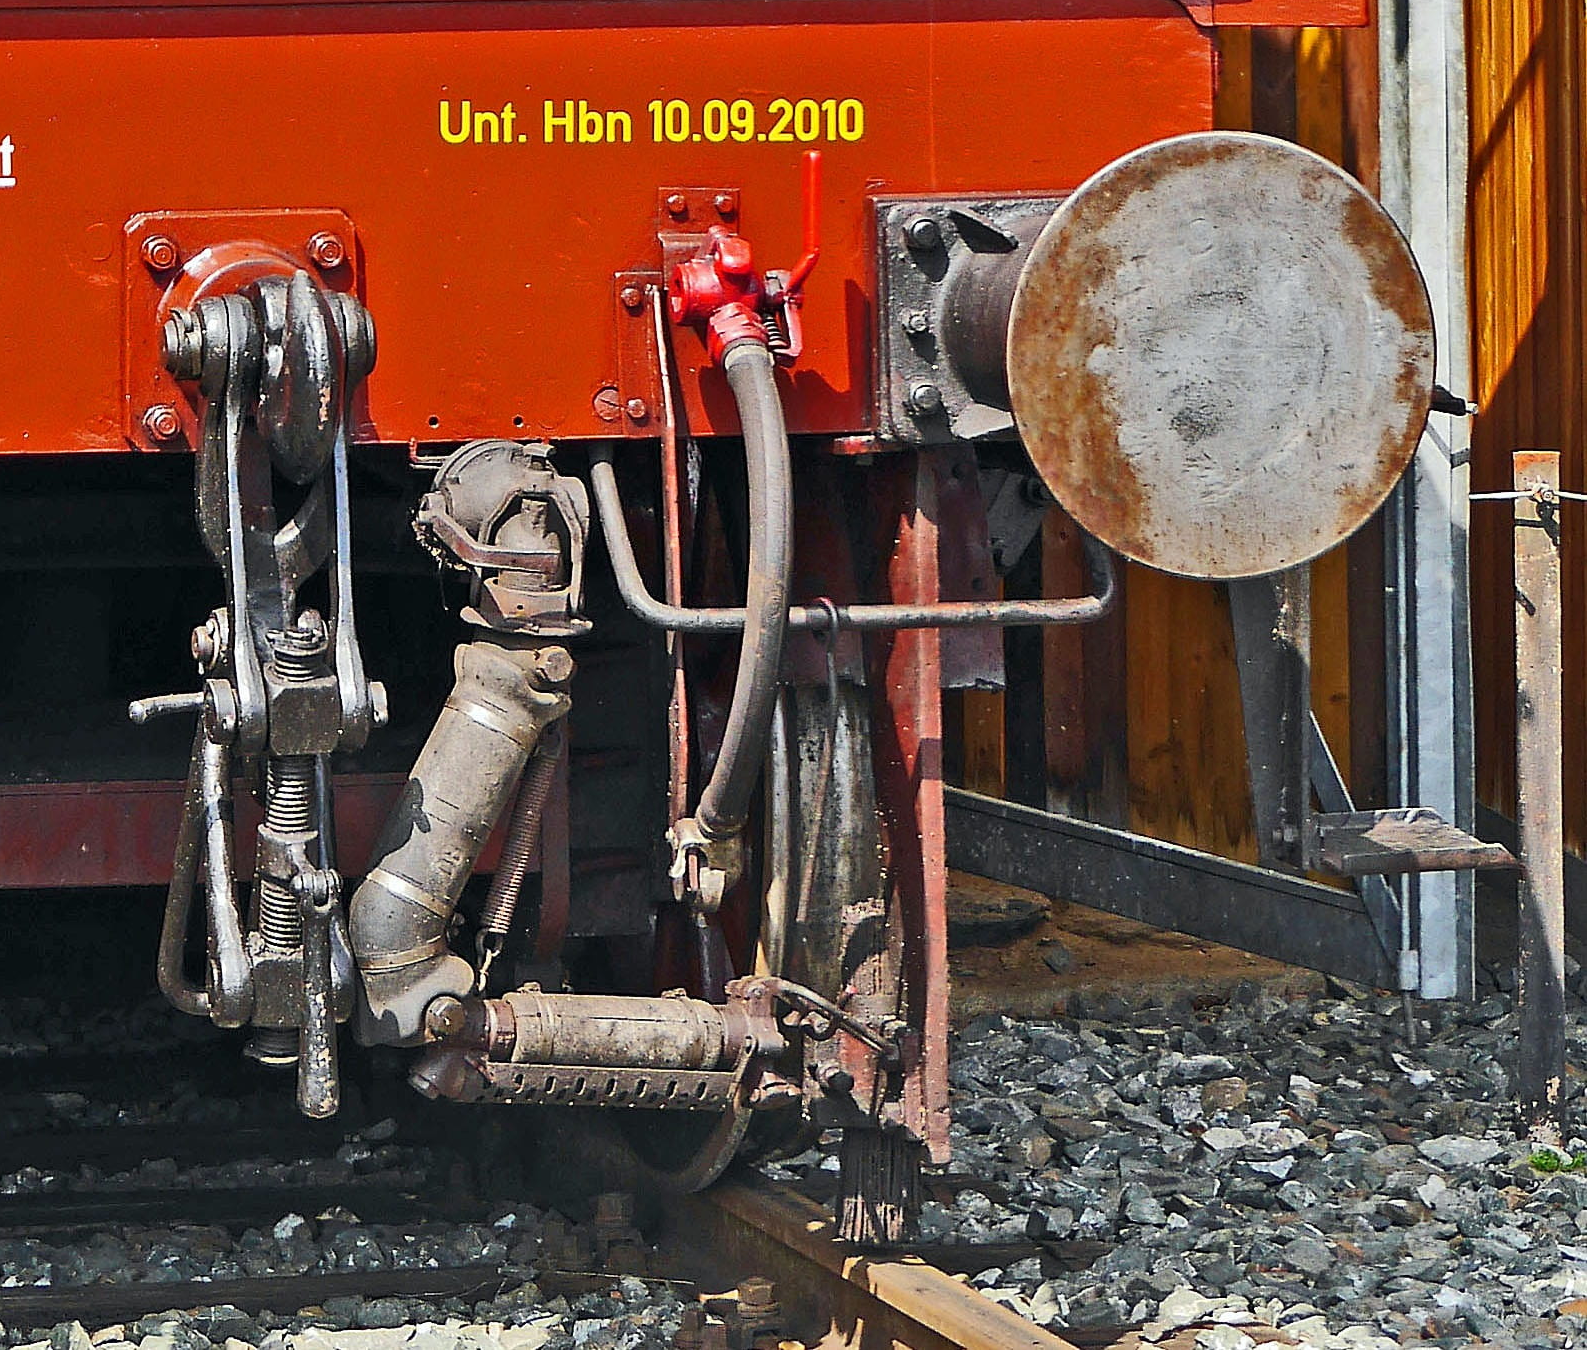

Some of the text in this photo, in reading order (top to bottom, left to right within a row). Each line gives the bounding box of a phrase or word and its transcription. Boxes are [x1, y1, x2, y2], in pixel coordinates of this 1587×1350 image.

[439, 98, 865, 144] Unt. Hbn 10.09.2010
